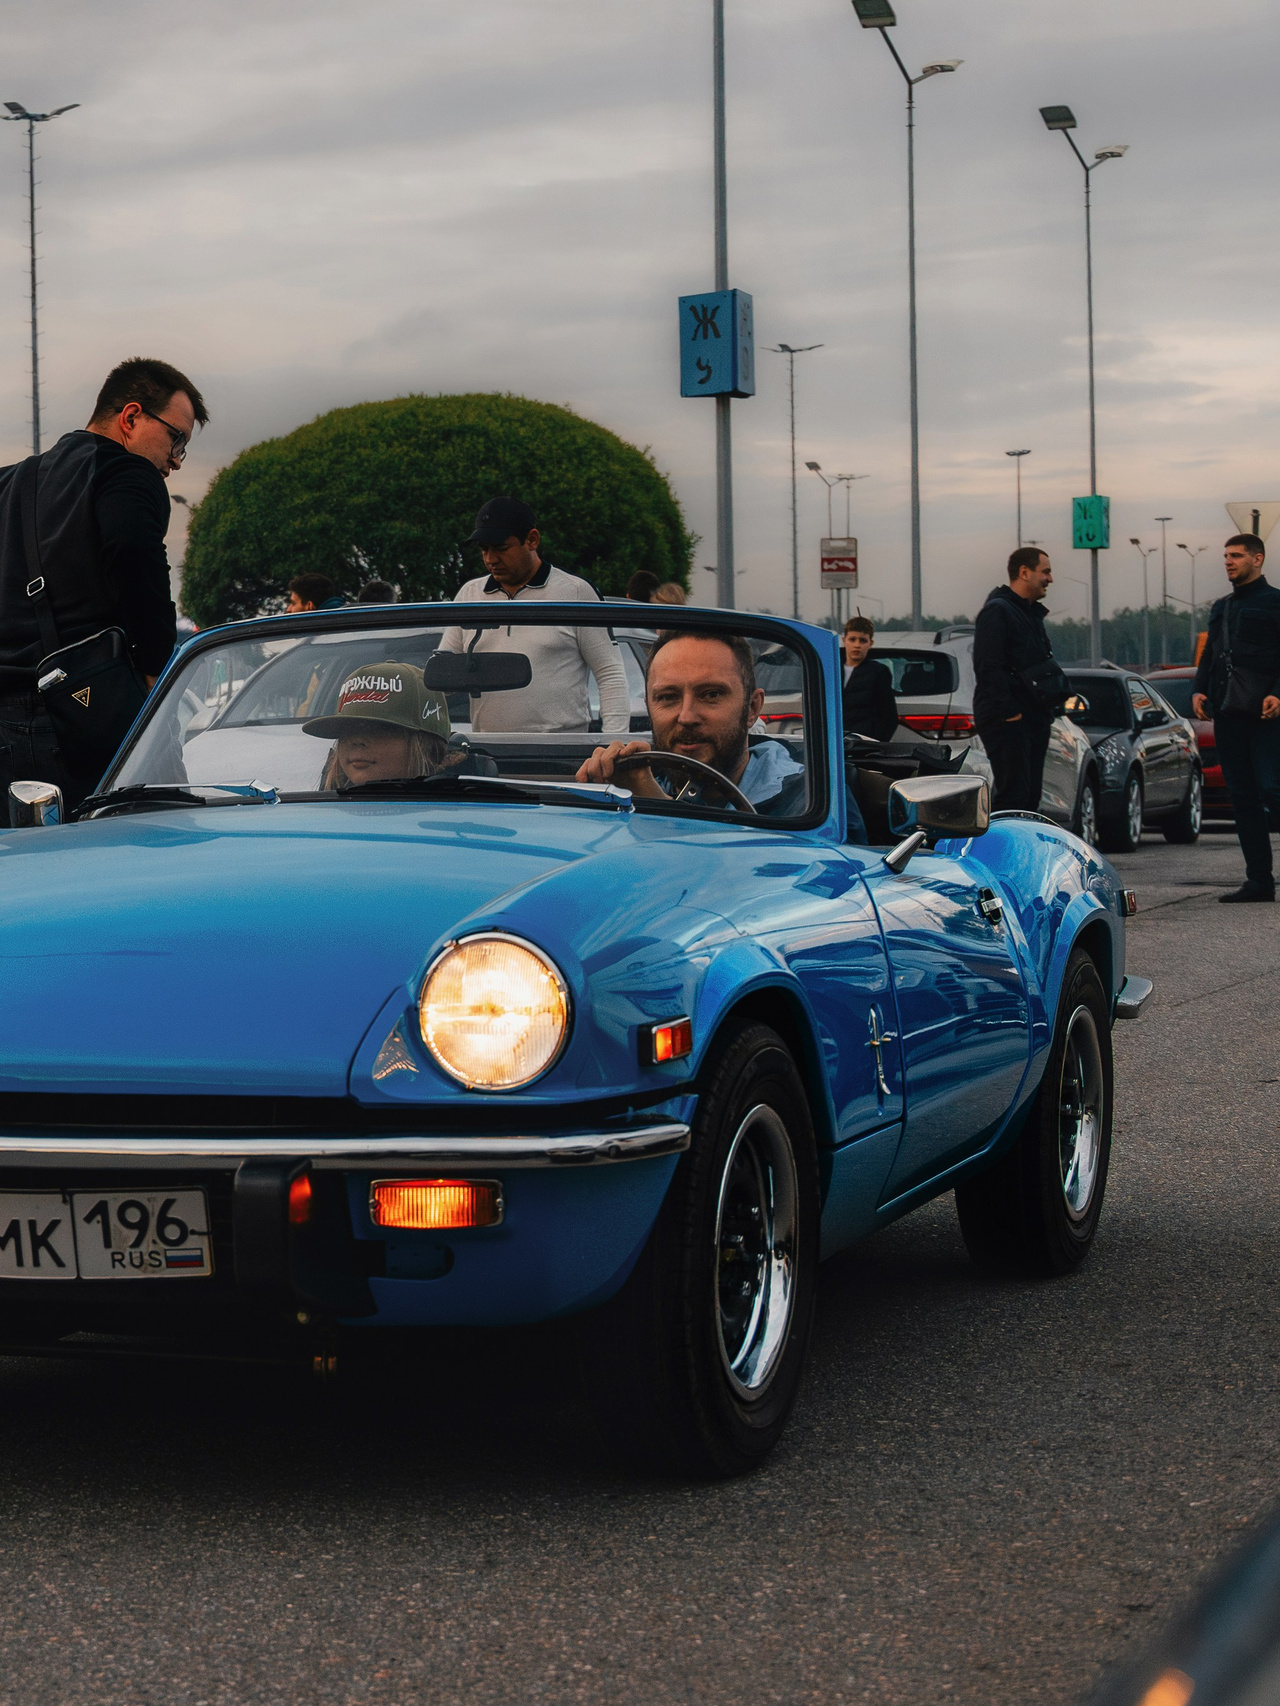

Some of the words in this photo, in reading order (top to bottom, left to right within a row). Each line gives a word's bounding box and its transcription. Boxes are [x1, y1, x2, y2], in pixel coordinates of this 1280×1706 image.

[689, 303, 721, 341] Ж
[82, 1198, 190, 1250] 196
[111, 1248, 163, 1270] RUS
